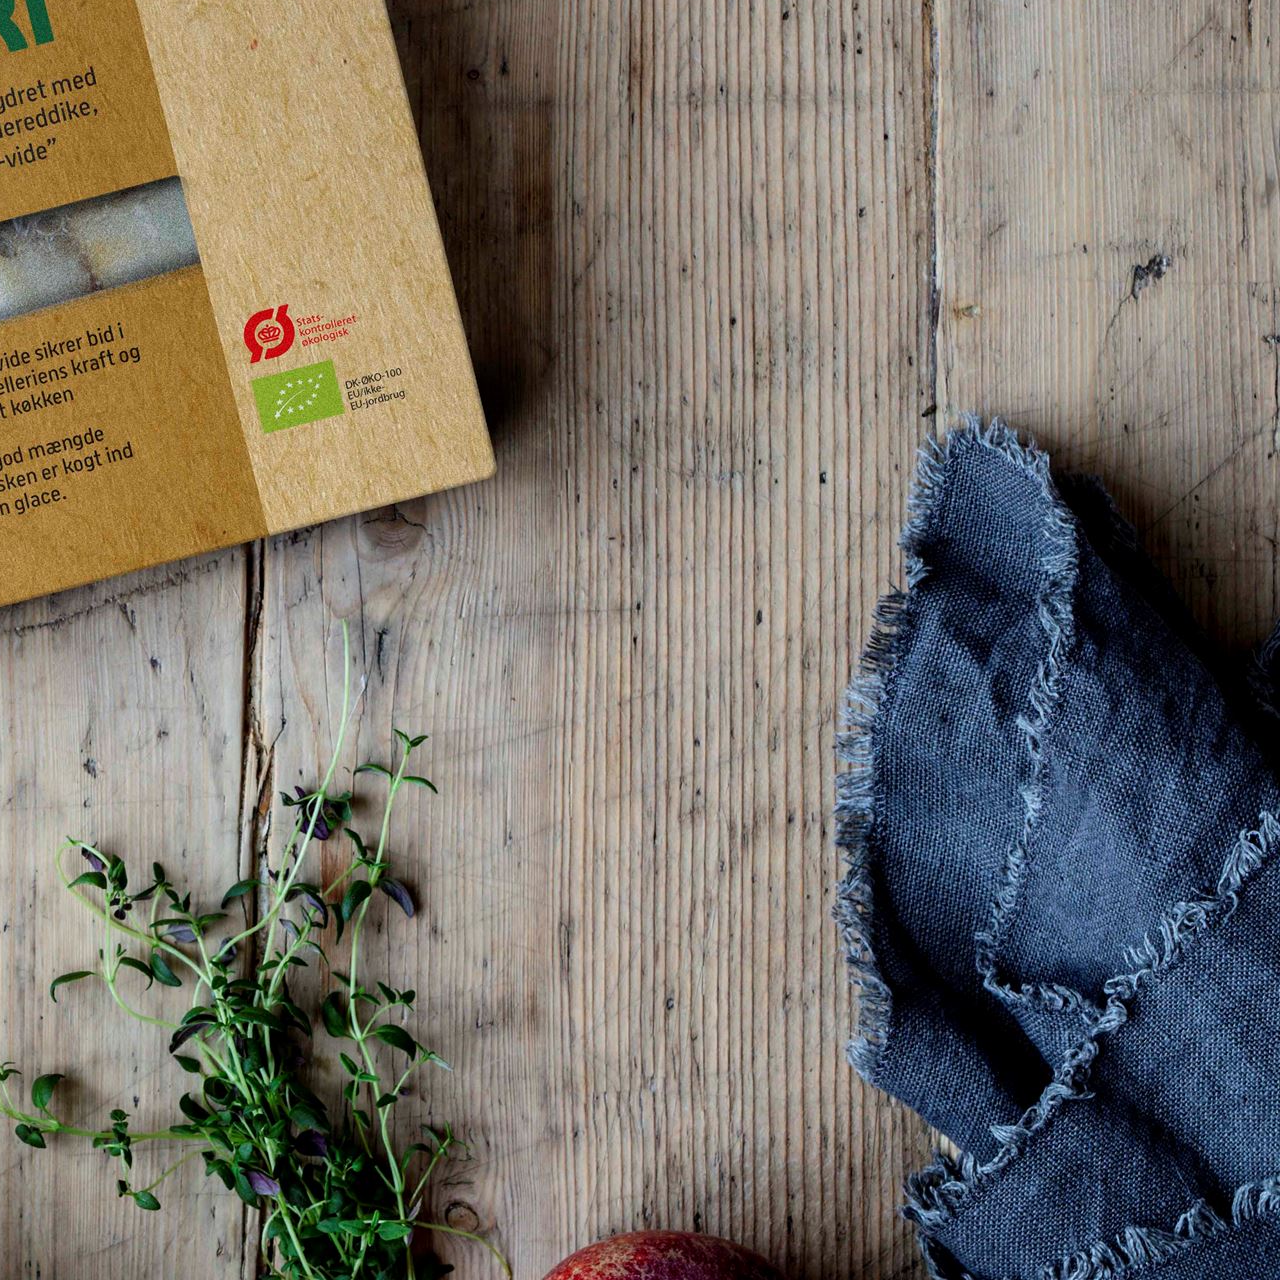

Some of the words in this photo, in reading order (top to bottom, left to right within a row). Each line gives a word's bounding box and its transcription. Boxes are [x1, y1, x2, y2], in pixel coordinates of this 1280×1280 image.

[51, 65, 97, 96] med
[296, 314, 324, 327] Stats-
[298, 315, 357, 337] kontrolleret
[33, 336, 83, 362] sikrer
[85, 324, 115, 347] bid
[116, 321, 125, 339] i
[301, 327, 349, 347] økologisk
[69, 348, 116, 376] kraft
[118, 346, 141, 364] og
[345, 367, 402, 390] DK-ØKO-100
[347, 384, 385, 400] EU/ikke-
[9, 388, 75, 416] køkken
[350, 389, 406, 411] EU-jordbrug
[27, 426, 105, 461] mængde
[41, 464, 59, 481] er
[61, 449, 103, 475] kogt
[104, 440, 134, 464] ind
[13, 488, 68, 515] glace.
